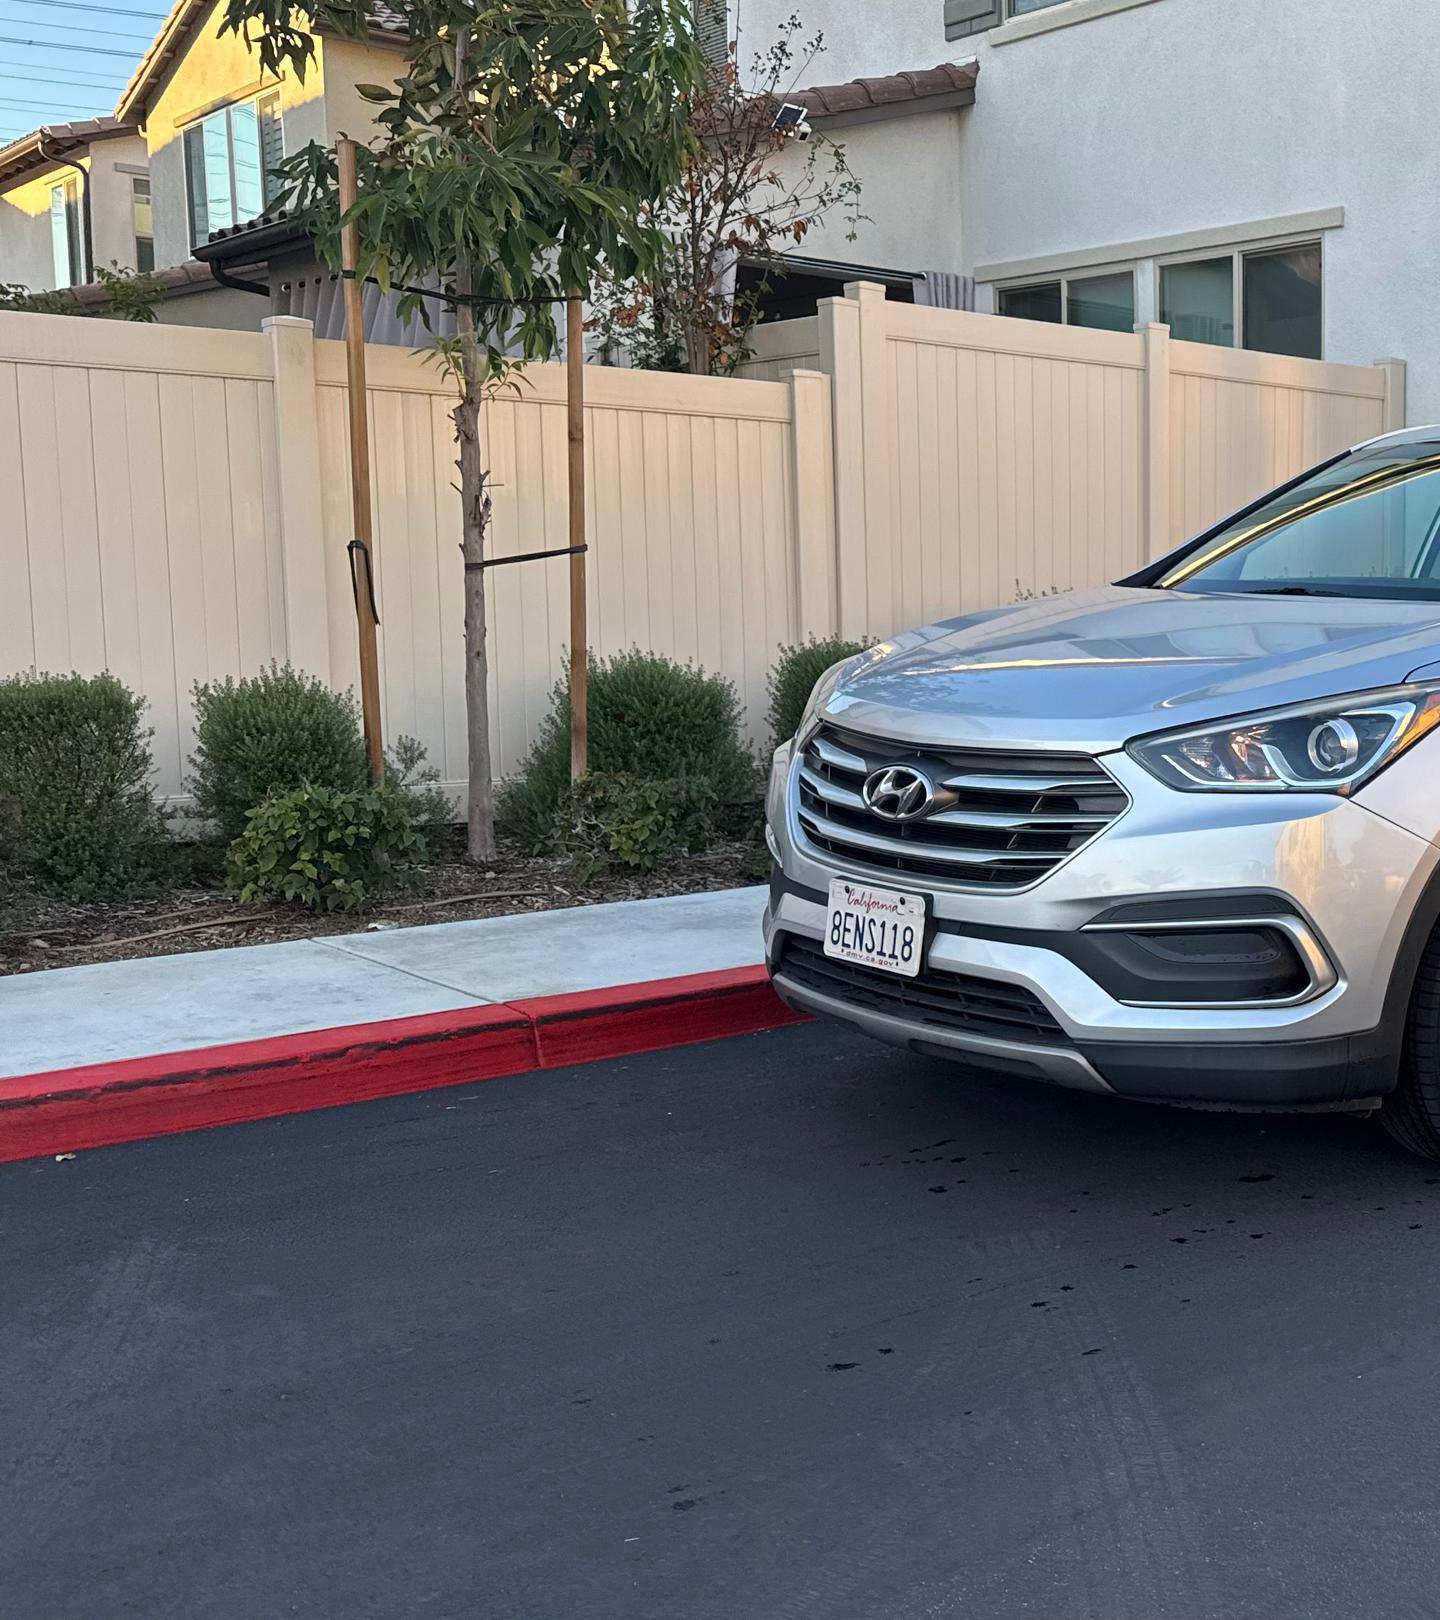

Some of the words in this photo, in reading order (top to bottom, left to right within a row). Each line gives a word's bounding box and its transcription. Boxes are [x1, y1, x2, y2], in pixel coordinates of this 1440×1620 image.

[847, 888, 904, 915] California
[831, 910, 914, 962] 8ENS118
[846, 951, 894, 965] dmv.ca.gov
